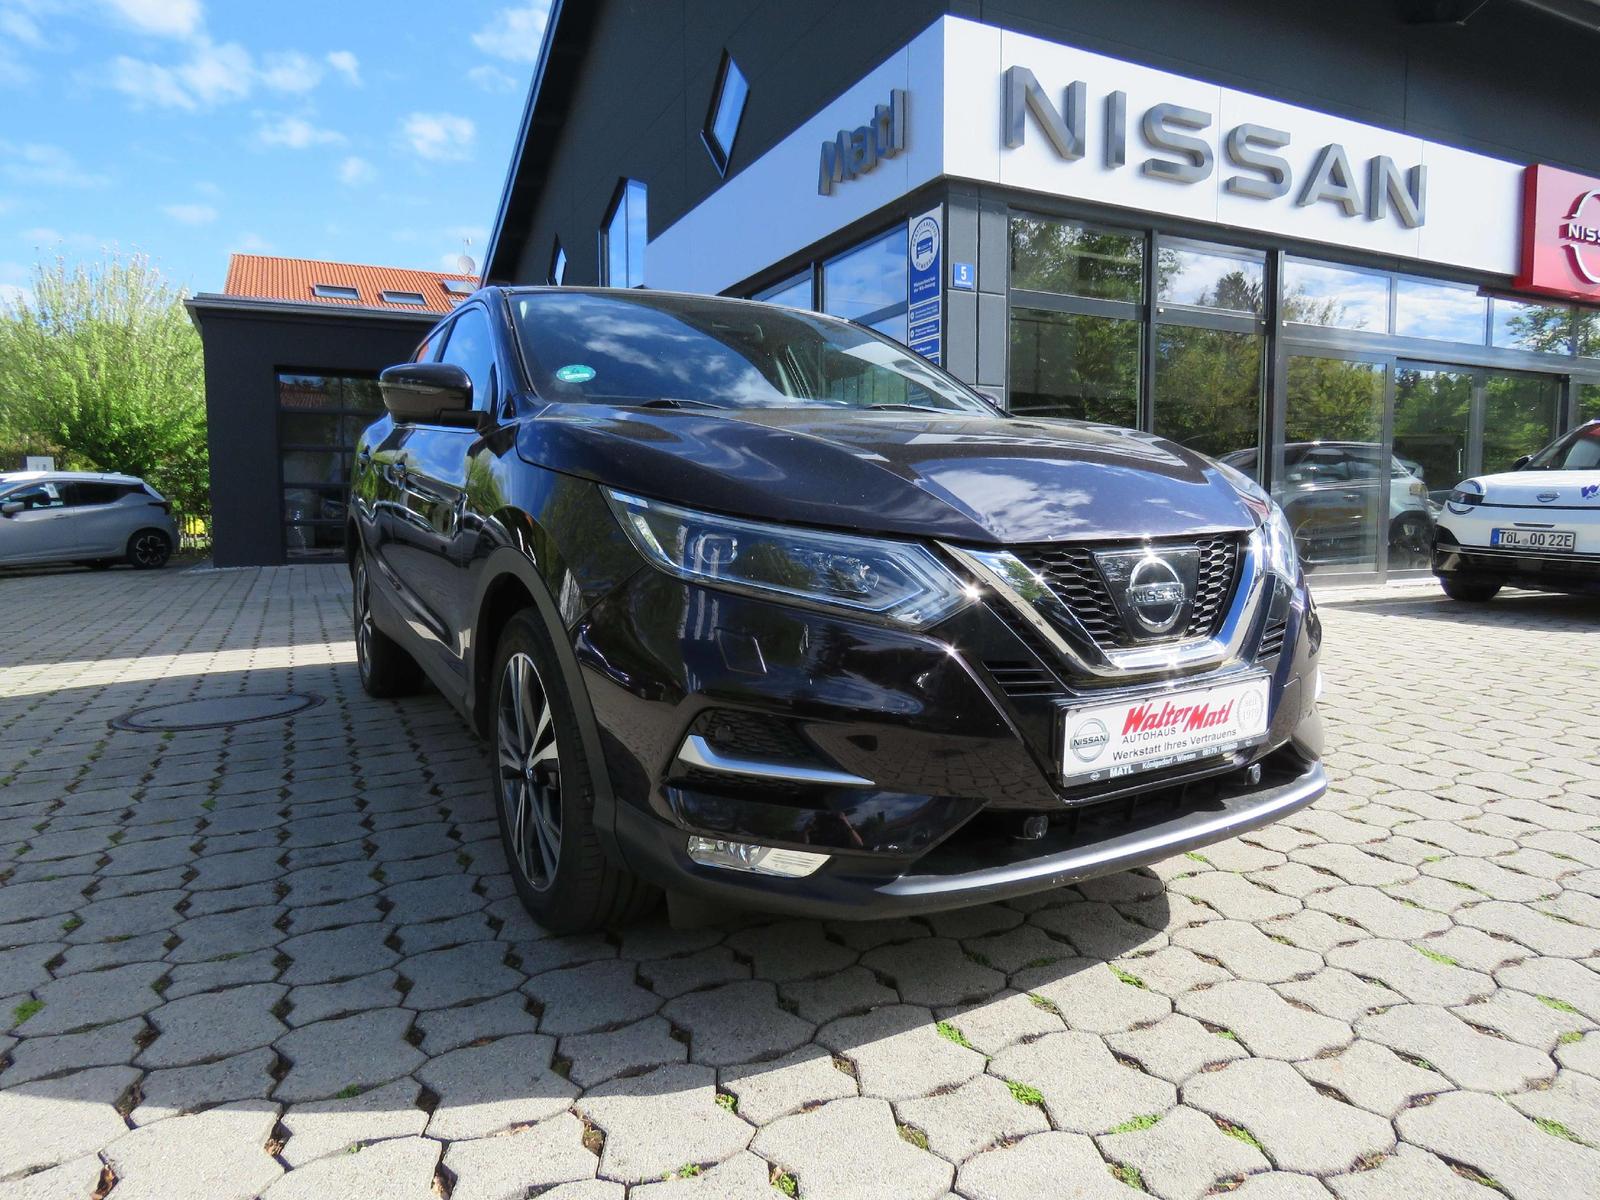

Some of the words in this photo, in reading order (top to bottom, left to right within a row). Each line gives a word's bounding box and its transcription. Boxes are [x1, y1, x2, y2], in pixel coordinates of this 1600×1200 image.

[818, 88, 904, 196] Matl
[1006, 65, 1428, 229] NISSAN
[960, 266, 968, 281] 5
[1500, 531, 1520, 544] TÖL
[1548, 534, 1572, 548] 22E
[1133, 587, 1184, 602] NISSAN
[1121, 702, 1192, 736] Walter
[1183, 699, 1235, 733] Matl
[1073, 734, 1107, 747] NISSAN
[1122, 726, 1177, 744] AUTOHAUS
[1112, 745, 1161, 761] Werkstatt
[1164, 740, 1188, 752] Ihres
[1190, 728, 1238, 746] Vertrauens
[1109, 765, 1134, 778] MATL
